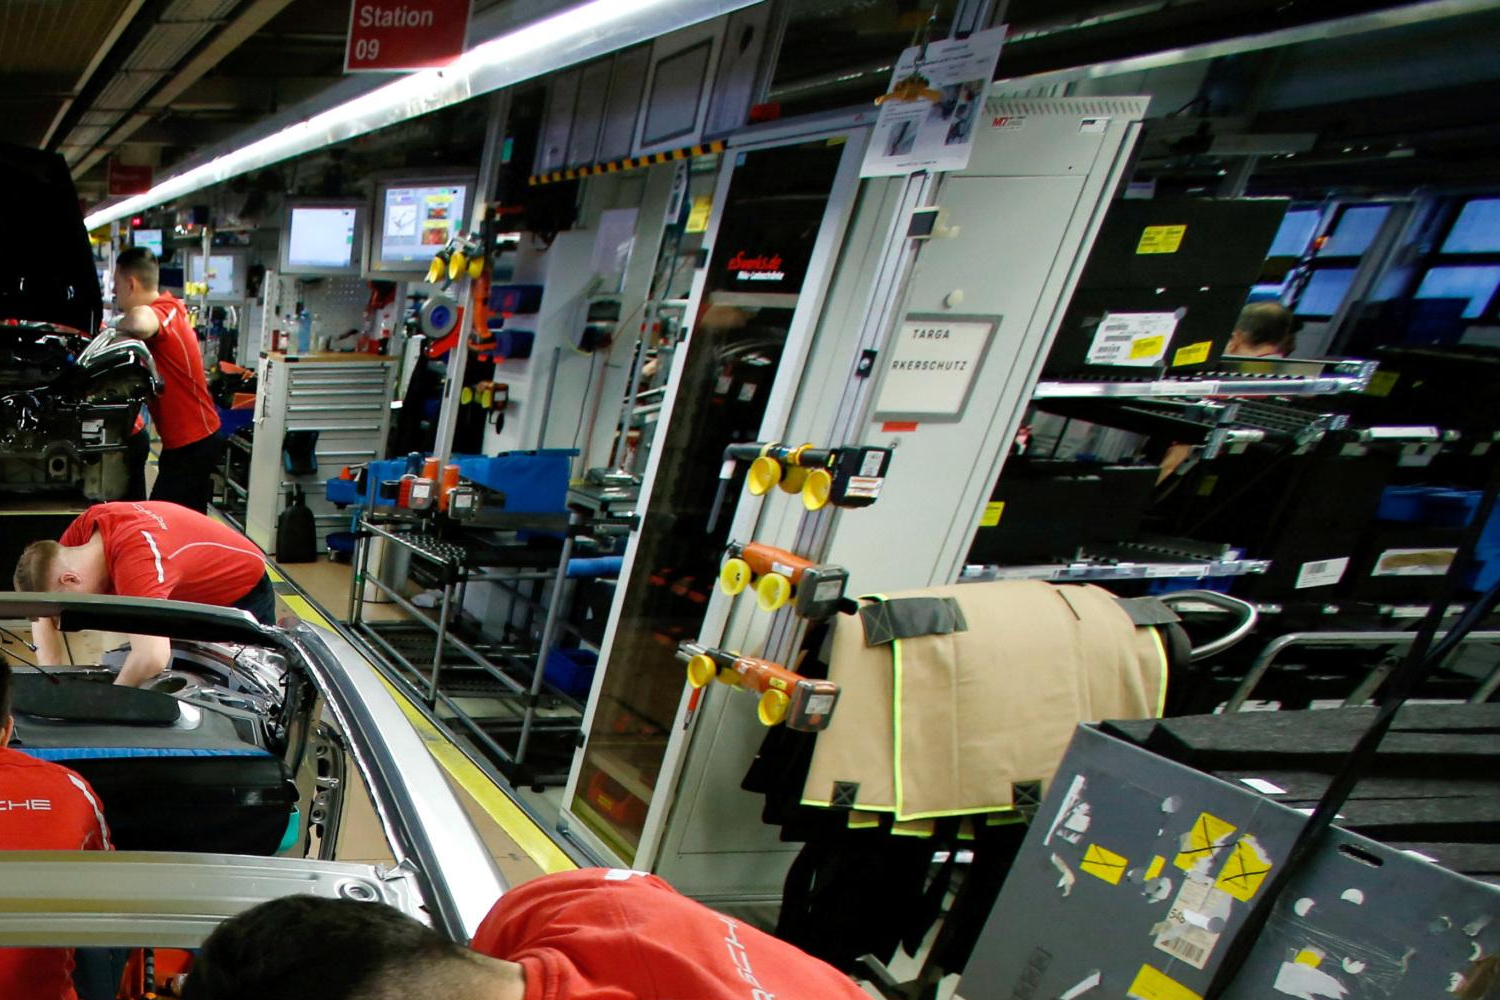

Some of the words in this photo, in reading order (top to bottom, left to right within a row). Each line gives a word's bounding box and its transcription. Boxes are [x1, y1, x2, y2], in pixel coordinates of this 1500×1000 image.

[360, 5, 434, 27] Station
[355, 39, 380, 60] 09
[912, 329, 951, 339] TARGA
